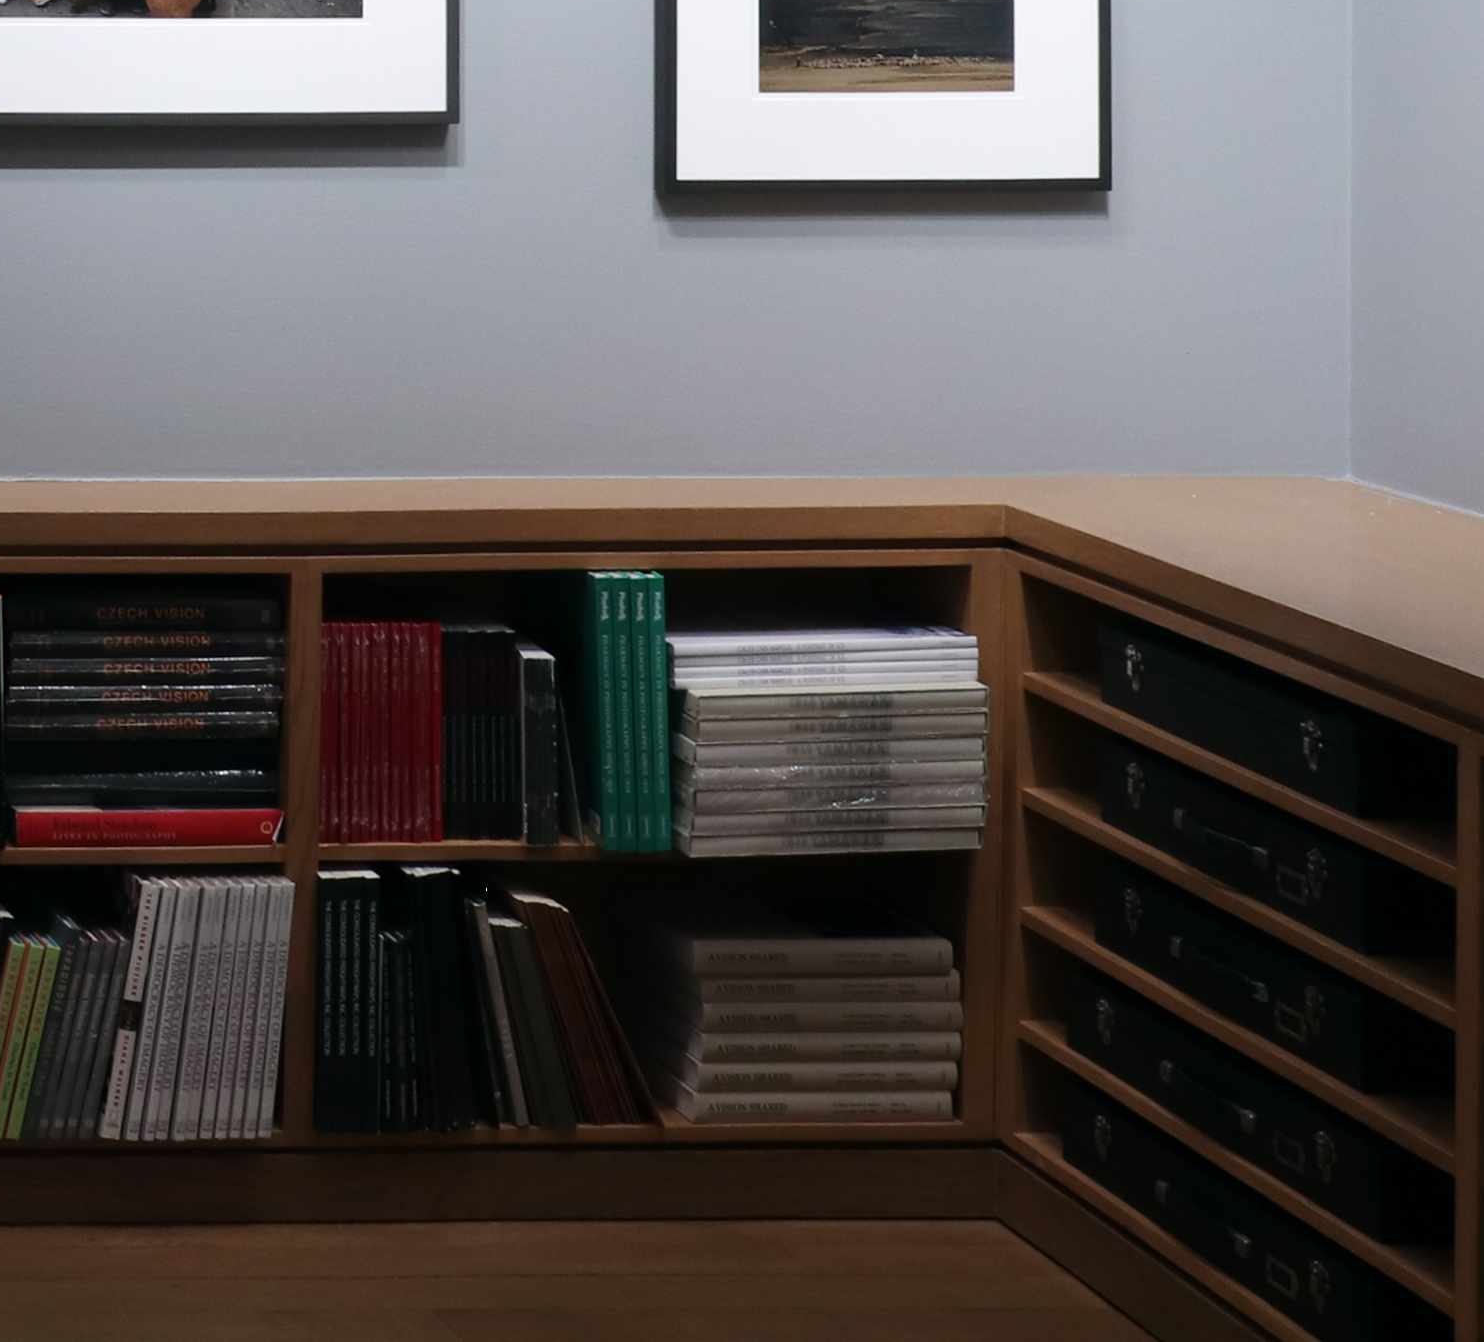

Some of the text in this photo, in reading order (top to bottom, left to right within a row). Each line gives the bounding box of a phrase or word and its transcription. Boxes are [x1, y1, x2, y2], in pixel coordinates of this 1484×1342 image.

[96, 608, 206, 620] CZECH VISION
[102, 636, 211, 648] CZECH VISION
[103, 662, 211, 675] CZECH VISION
[52, 832, 177, 840] LIVES IN PHOTOGRAPHY
[130, 894, 152, 996] THE BIGGER PICTURE
[266, 940, 288, 1090] A DEMOCRACY OF IMAGERY
